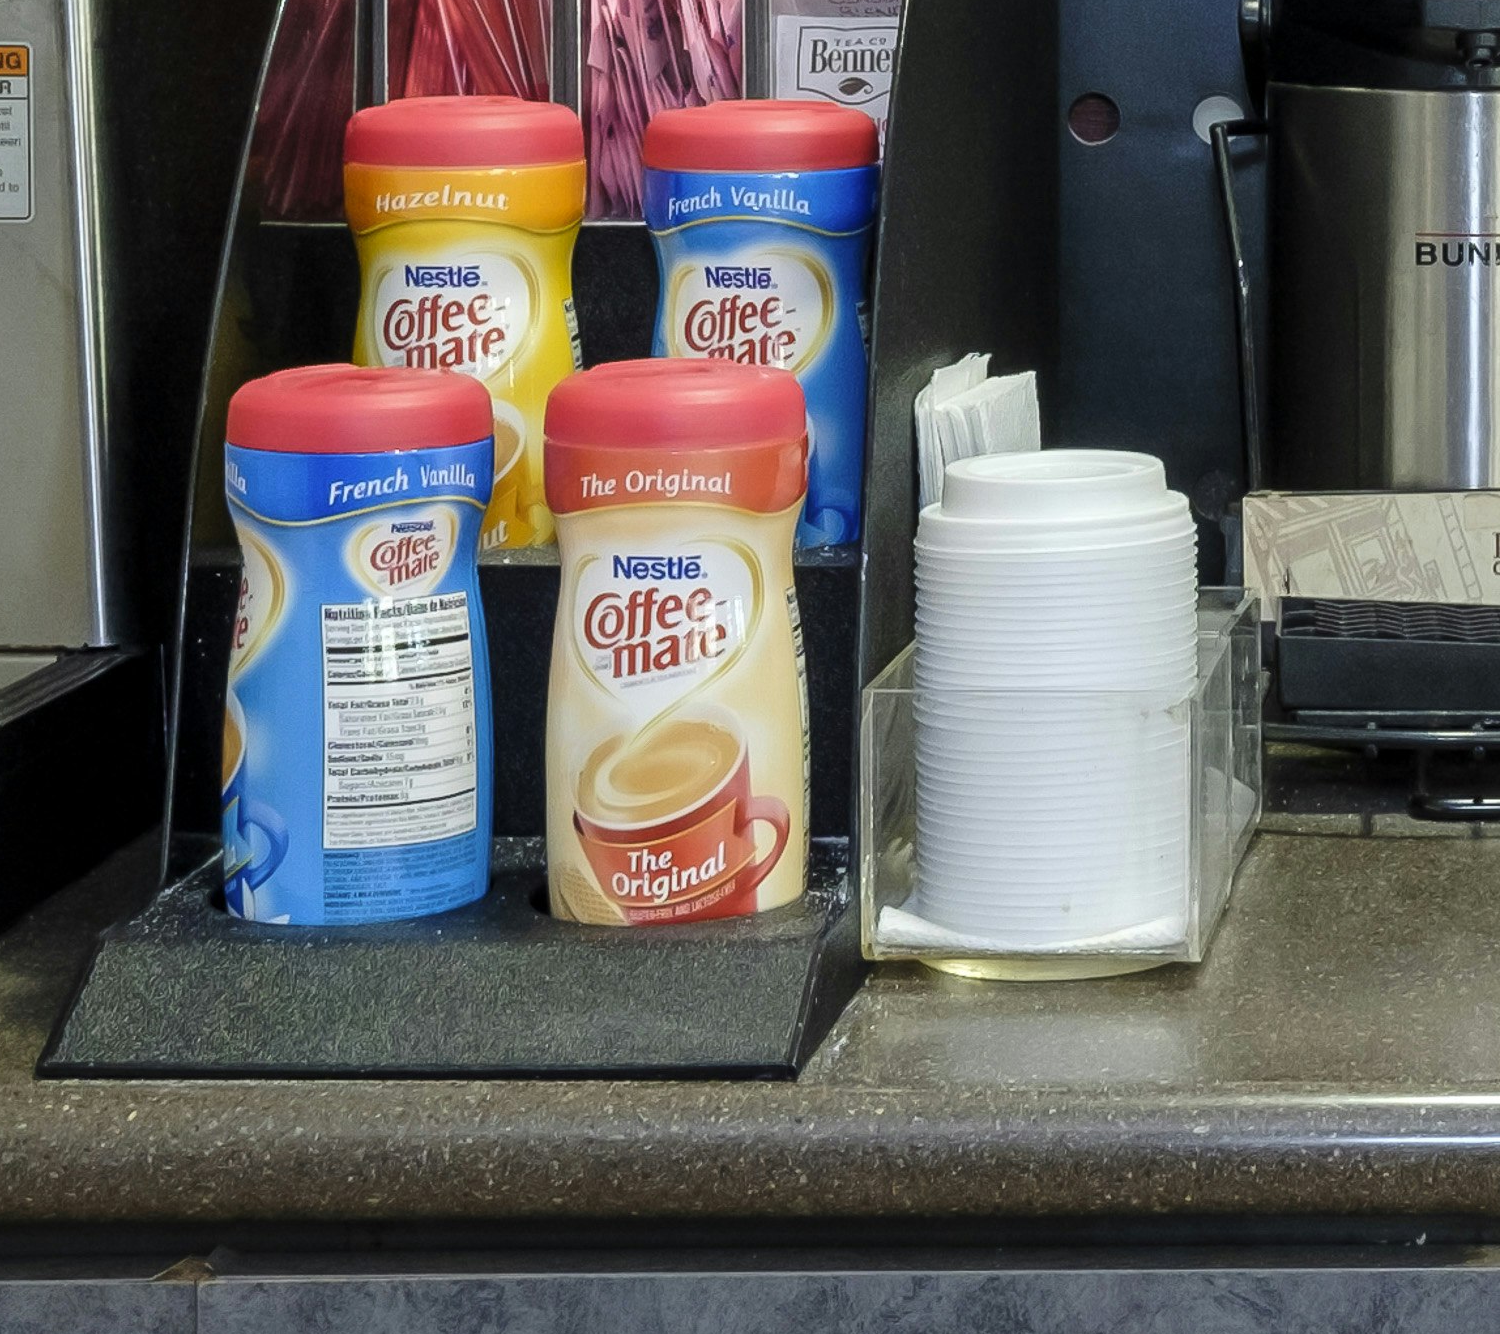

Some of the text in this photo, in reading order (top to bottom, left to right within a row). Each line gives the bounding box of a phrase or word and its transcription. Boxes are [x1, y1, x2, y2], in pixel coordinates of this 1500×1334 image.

[834, 37, 864, 46] TEA
[9, 183, 20, 192] to
[376, 185, 510, 213] Hazelnut
[668, 186, 812, 220] French Vanilla
[405, 265, 480, 287] Nestlé
[704, 266, 772, 289] Nestlé
[405, 327, 506, 369] mate
[329, 464, 475, 506] French Vanilla
[580, 469, 732, 498] The Original
[388, 551, 440, 586] mate
[613, 555, 701, 580] Nestlé
[612, 624, 726, 678] mate
[612, 841, 727, 903] Original
[628, 848, 672, 873] The
